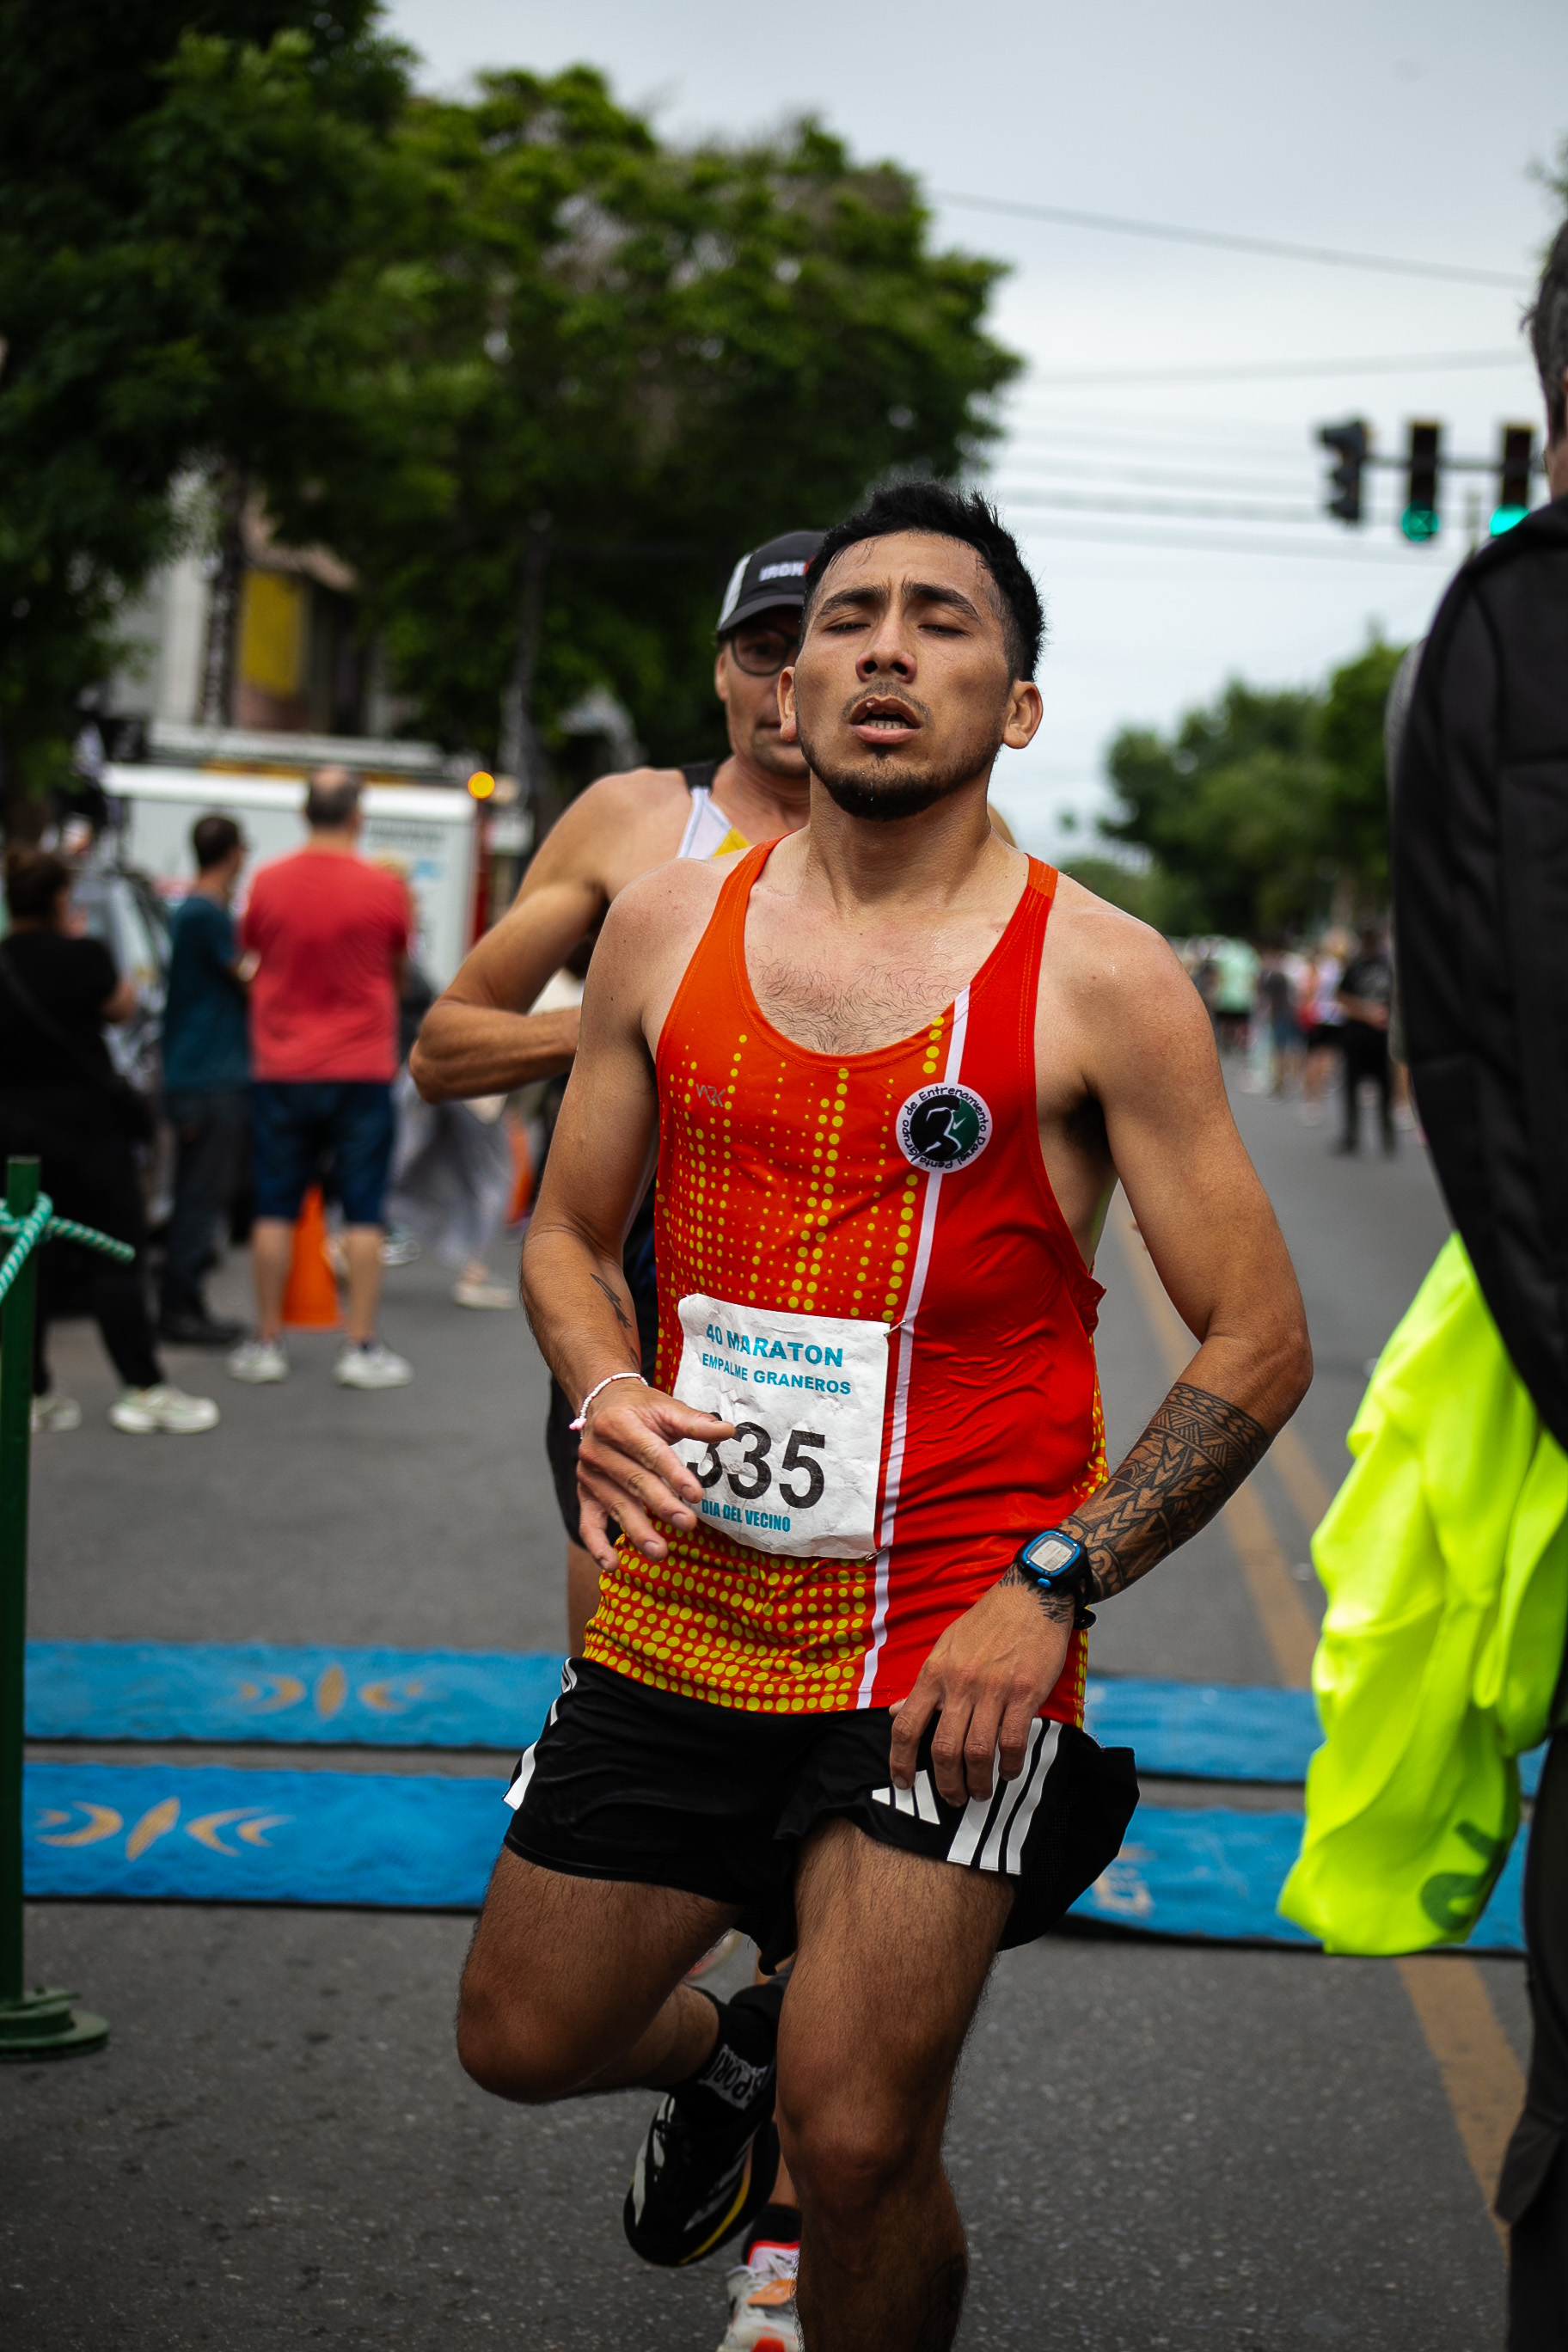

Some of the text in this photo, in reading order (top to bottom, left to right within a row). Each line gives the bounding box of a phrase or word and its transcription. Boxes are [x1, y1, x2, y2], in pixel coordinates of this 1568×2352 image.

[904, 1101, 918, 1116] de
[918, 1086, 989, 1132] Entrenamiento
[902, 1119, 920, 1156] Grupo
[959, 1136, 986, 1165] Daniel
[706, 1325, 843, 1368] 40 MARATON
[702, 1352, 851, 1395] EMPALME GRANEROS
[686, 1412, 825, 1509] 335
[701, 1499, 791, 1533] DIA DEL VECINO
